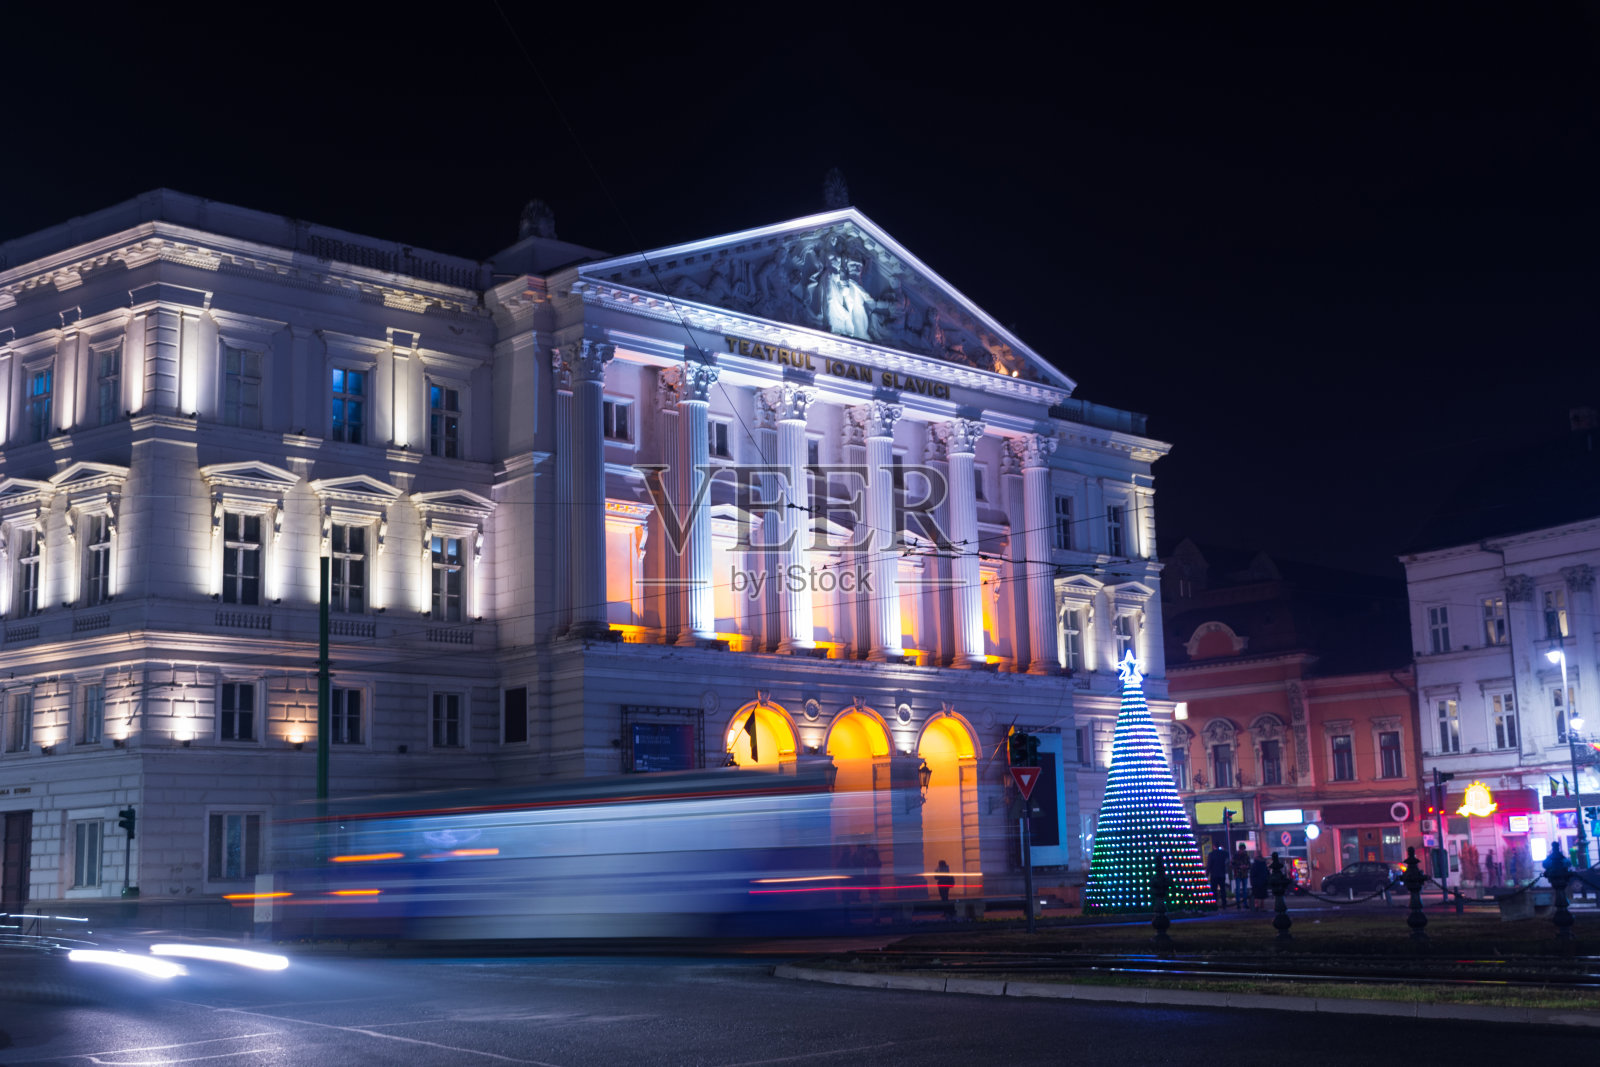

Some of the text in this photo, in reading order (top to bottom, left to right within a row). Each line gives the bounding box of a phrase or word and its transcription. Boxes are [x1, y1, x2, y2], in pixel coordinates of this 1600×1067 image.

[725, 336, 950, 400] TEATRUL IOAN SLAVICI
